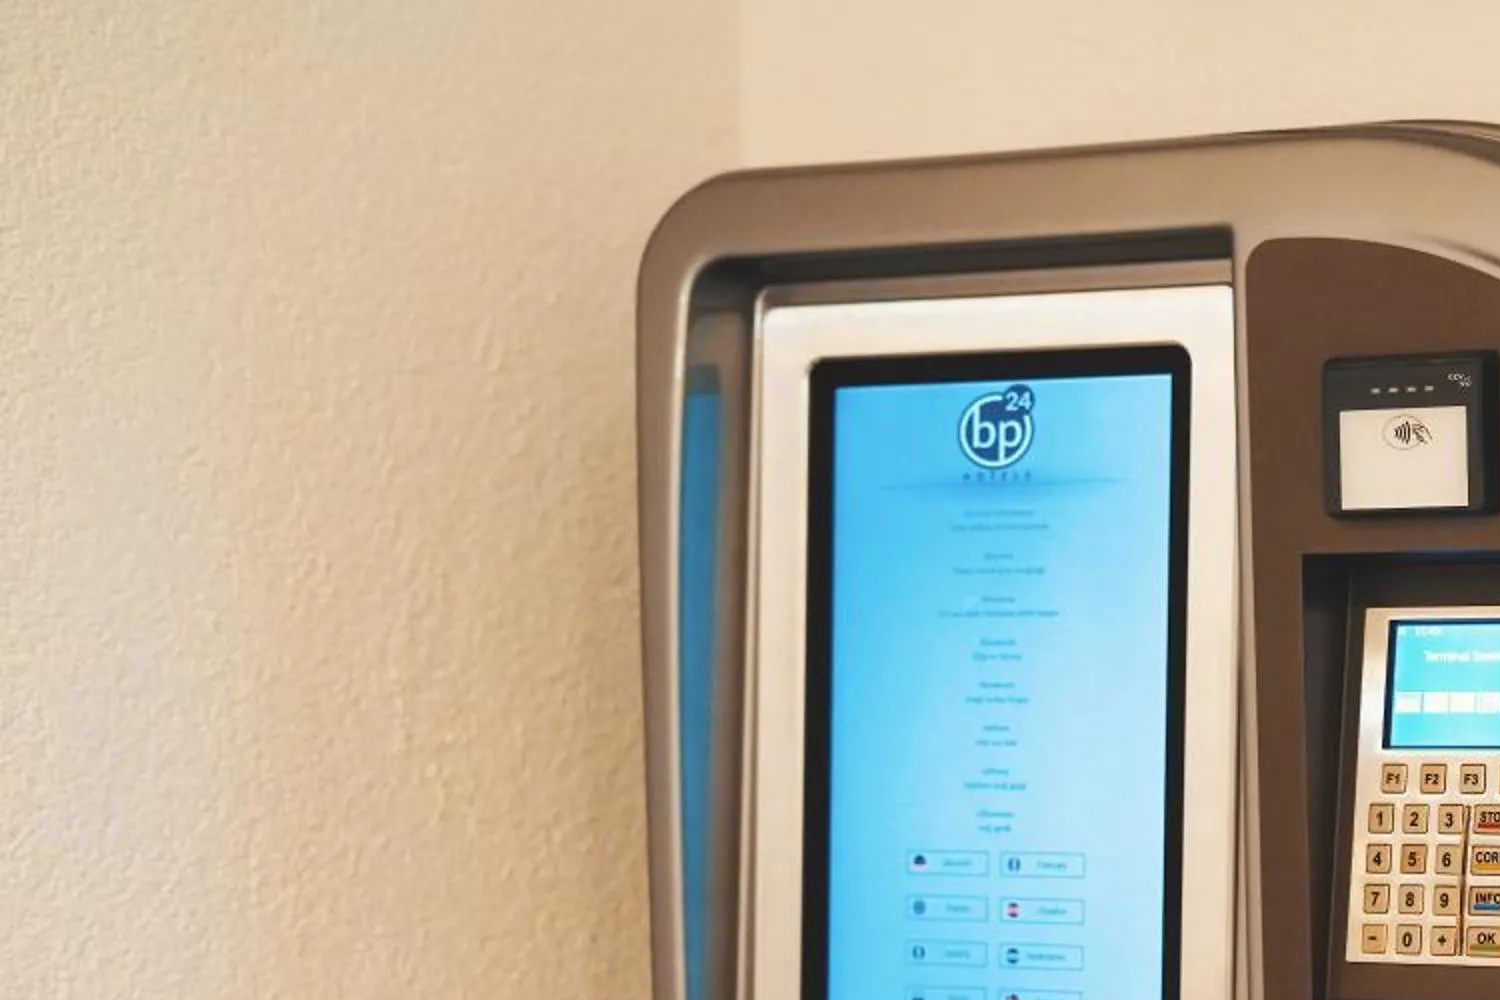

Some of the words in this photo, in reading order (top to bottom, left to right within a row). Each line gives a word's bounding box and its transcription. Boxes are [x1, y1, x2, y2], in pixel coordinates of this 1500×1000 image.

[1005, 391, 1032, 412] 24
[972, 404, 1024, 463] bp
[1385, 772, 1401, 785] F1
[1424, 772, 1440, 785] F2
[1463, 772, 1479, 785] F3
[1375, 813, 1384, 826] 1
[1408, 811, 1419, 827] 2
[1444, 813, 1454, 828] 3
[1372, 852, 1382, 866] 4
[1407, 852, 1417, 867] 5
[1441, 853, 1451, 867] 6
[1370, 891, 1380, 906] 7
[1404, 892, 1415, 907] 8
[1438, 892, 1449, 908] 9
[1402, 931, 1413, 948] 0
[1477, 932, 1497, 945] OK
